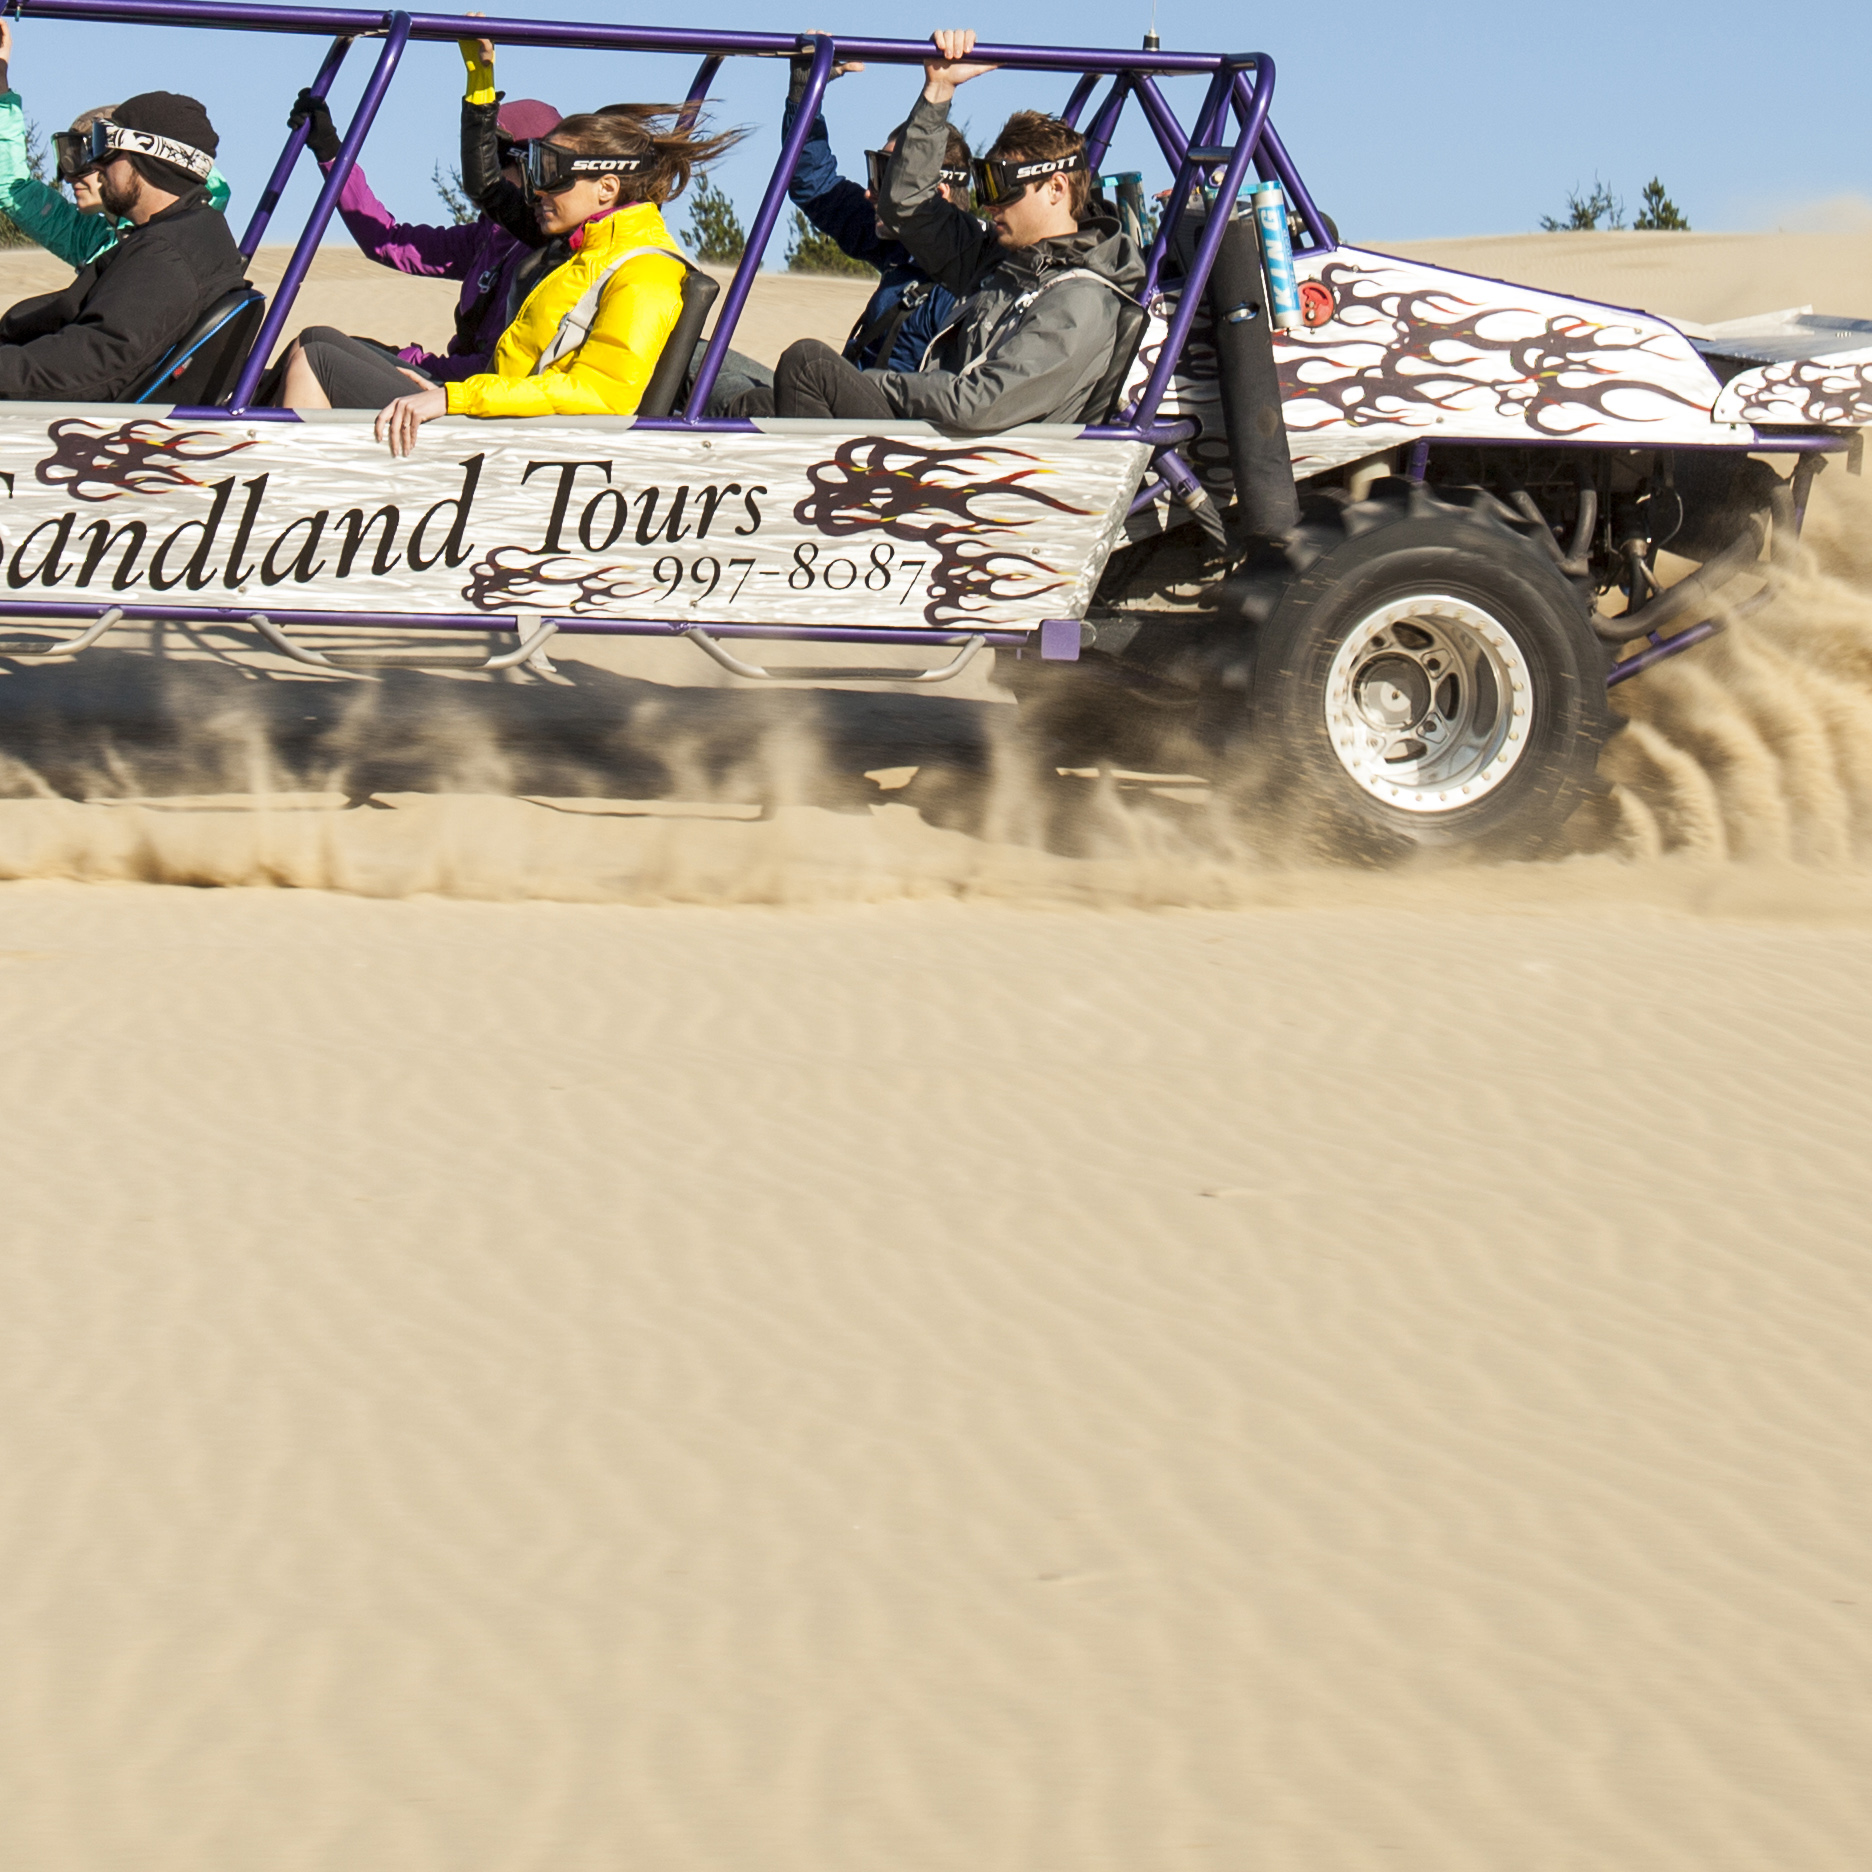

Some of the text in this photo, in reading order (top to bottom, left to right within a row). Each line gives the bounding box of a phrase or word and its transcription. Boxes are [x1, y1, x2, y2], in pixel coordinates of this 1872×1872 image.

[570, 159, 641, 171] SCOTT
[1016, 155, 1078, 179] SCOTT
[1260, 209, 1294, 309] KING
[520, 459, 768, 556] Tours
[652, 541, 927, 607] 997-8087
